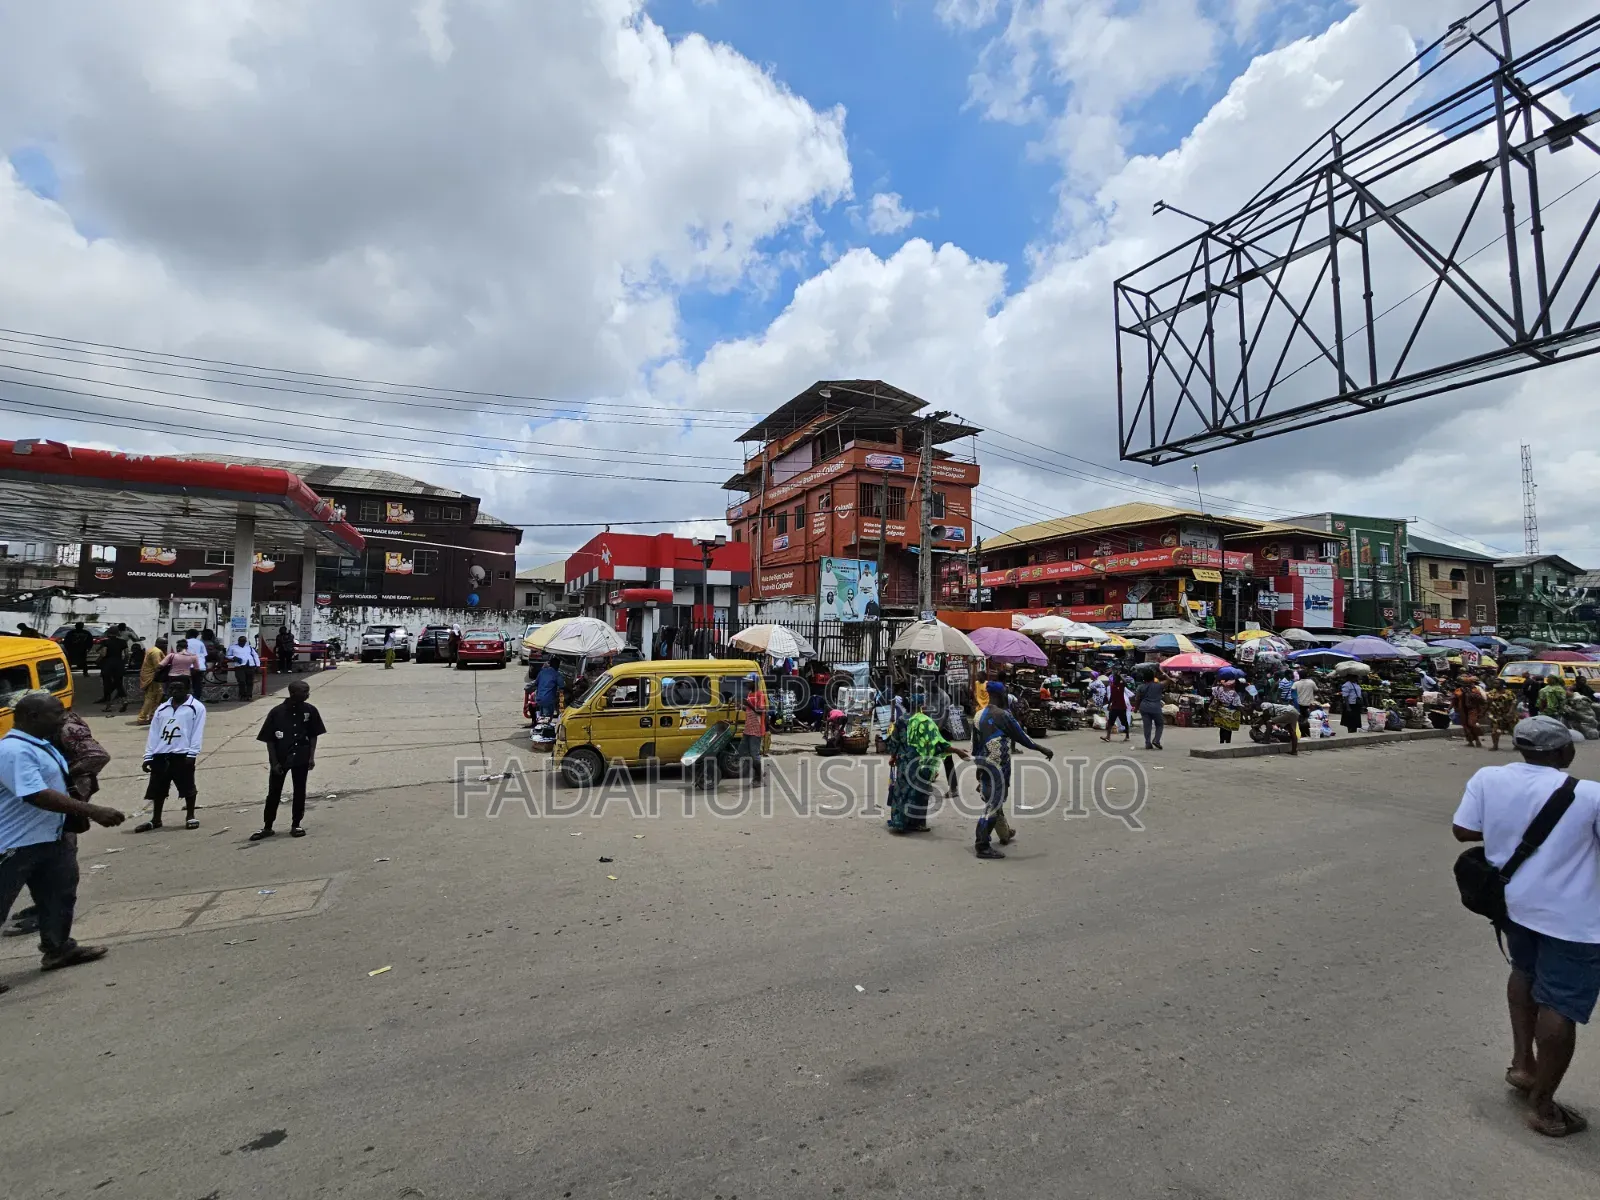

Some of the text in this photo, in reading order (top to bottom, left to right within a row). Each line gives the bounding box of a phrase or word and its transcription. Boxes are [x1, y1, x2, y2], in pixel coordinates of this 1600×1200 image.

[822, 458, 846, 476] Colgate
[834, 502, 854, 512] Colgate
[775, 581, 793, 590] Colgate
[918, 652, 940, 667] POS
